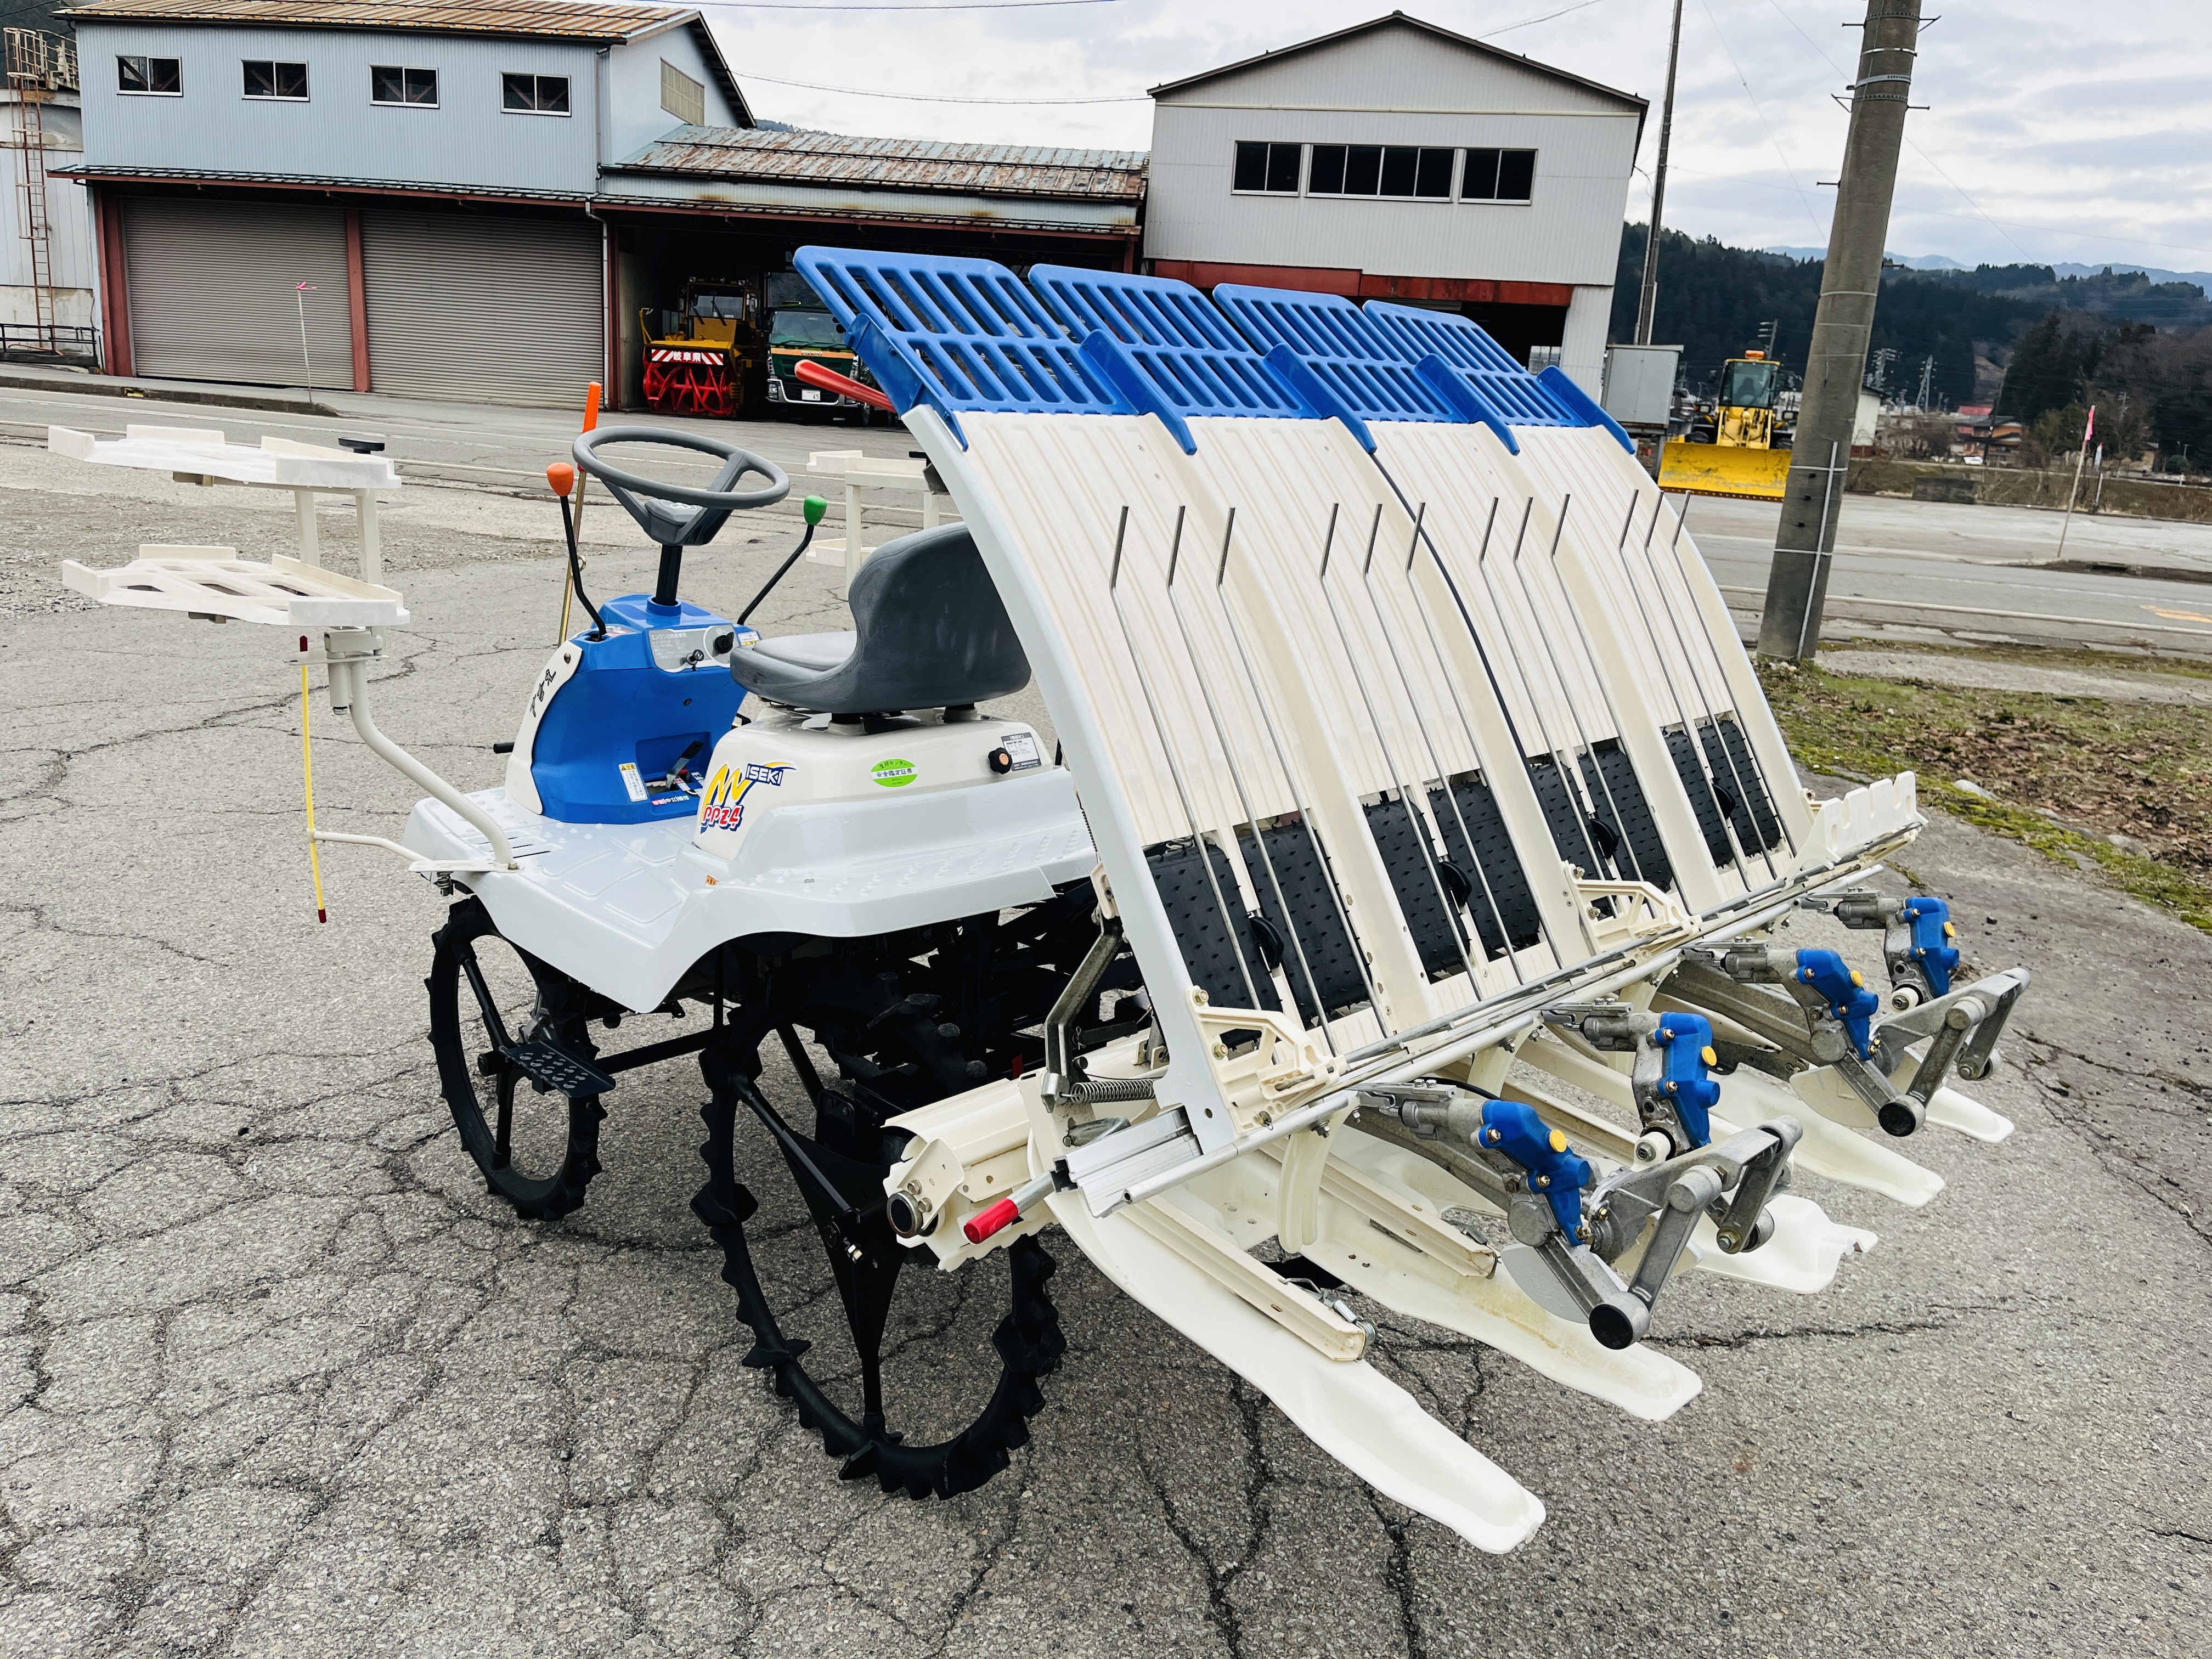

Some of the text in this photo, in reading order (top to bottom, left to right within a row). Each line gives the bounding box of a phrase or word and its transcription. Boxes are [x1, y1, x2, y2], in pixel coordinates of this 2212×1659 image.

[673, 351, 701, 362] 岐阜県
[746, 765, 783, 785] ISEKI
